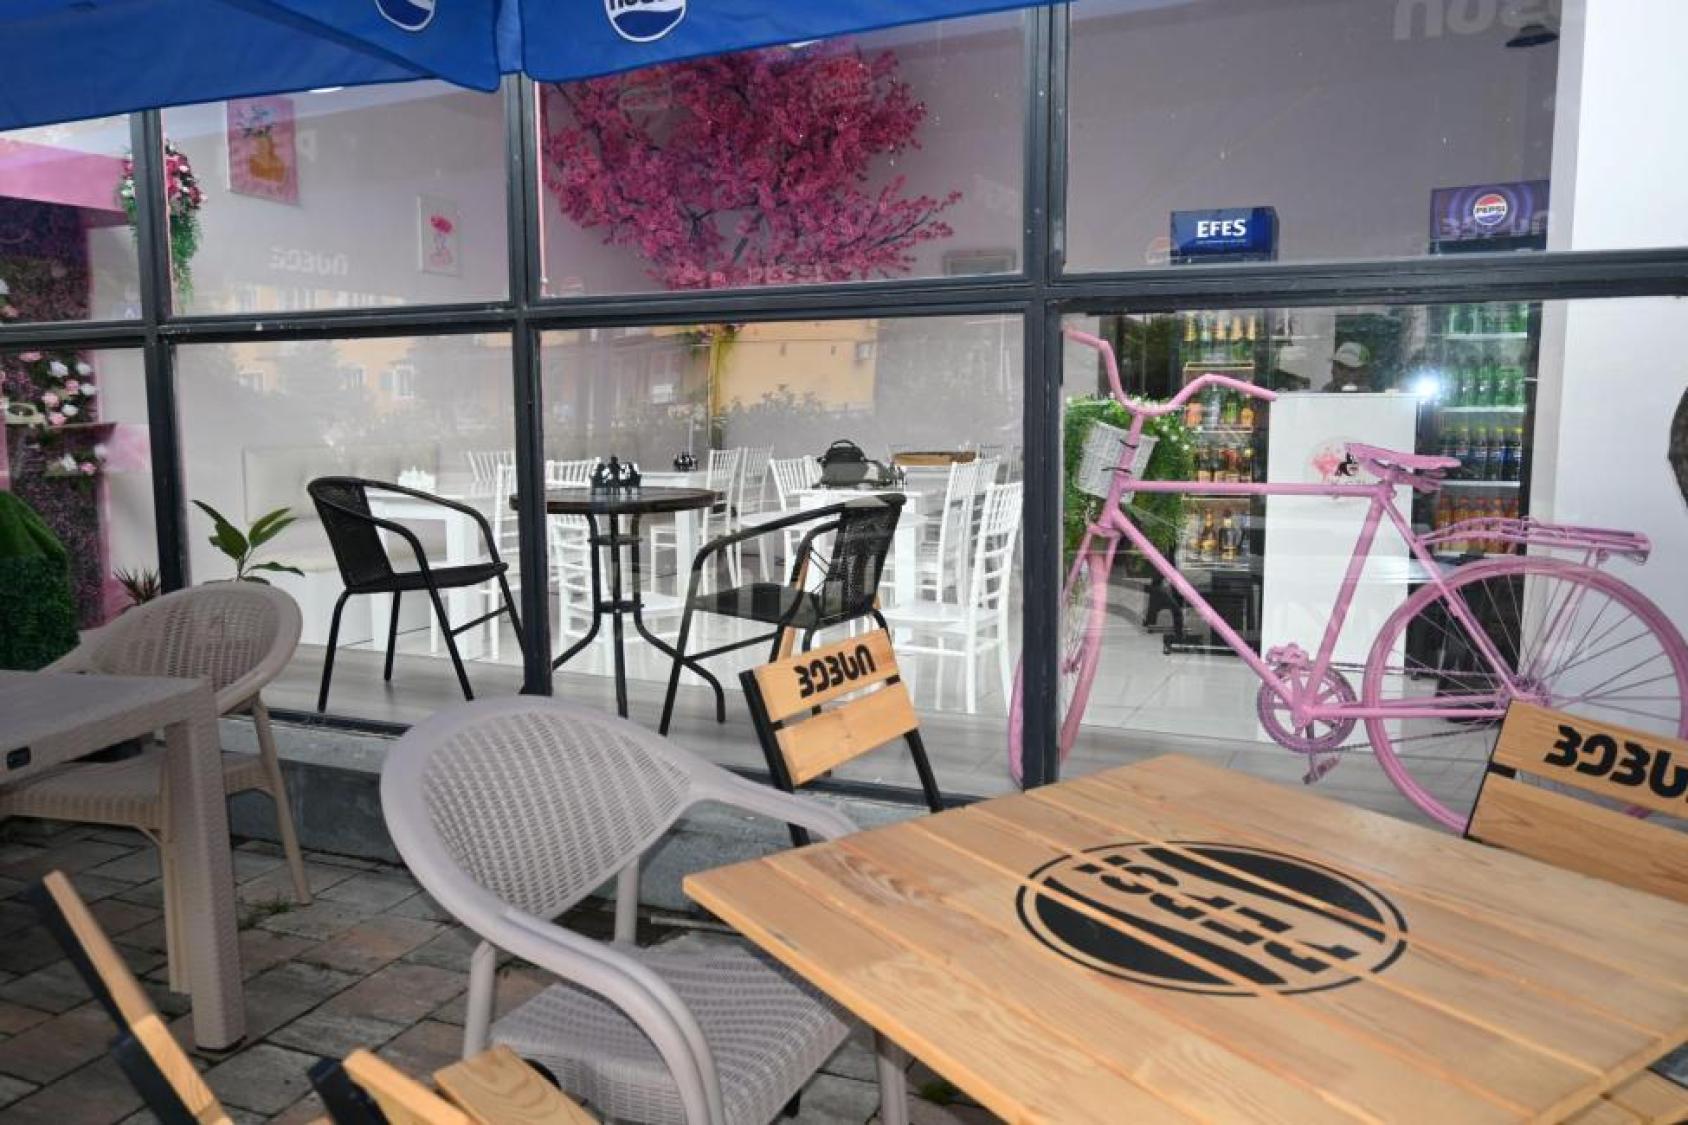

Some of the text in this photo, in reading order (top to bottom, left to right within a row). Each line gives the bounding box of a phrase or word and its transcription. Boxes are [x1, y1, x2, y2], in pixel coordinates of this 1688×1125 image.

[1196, 218, 1248, 239] EFES
[1475, 205, 1506, 214] PEPSI
[1543, 724, 1688, 798] პეპს
[1072, 854, 1361, 975] PEPSI
